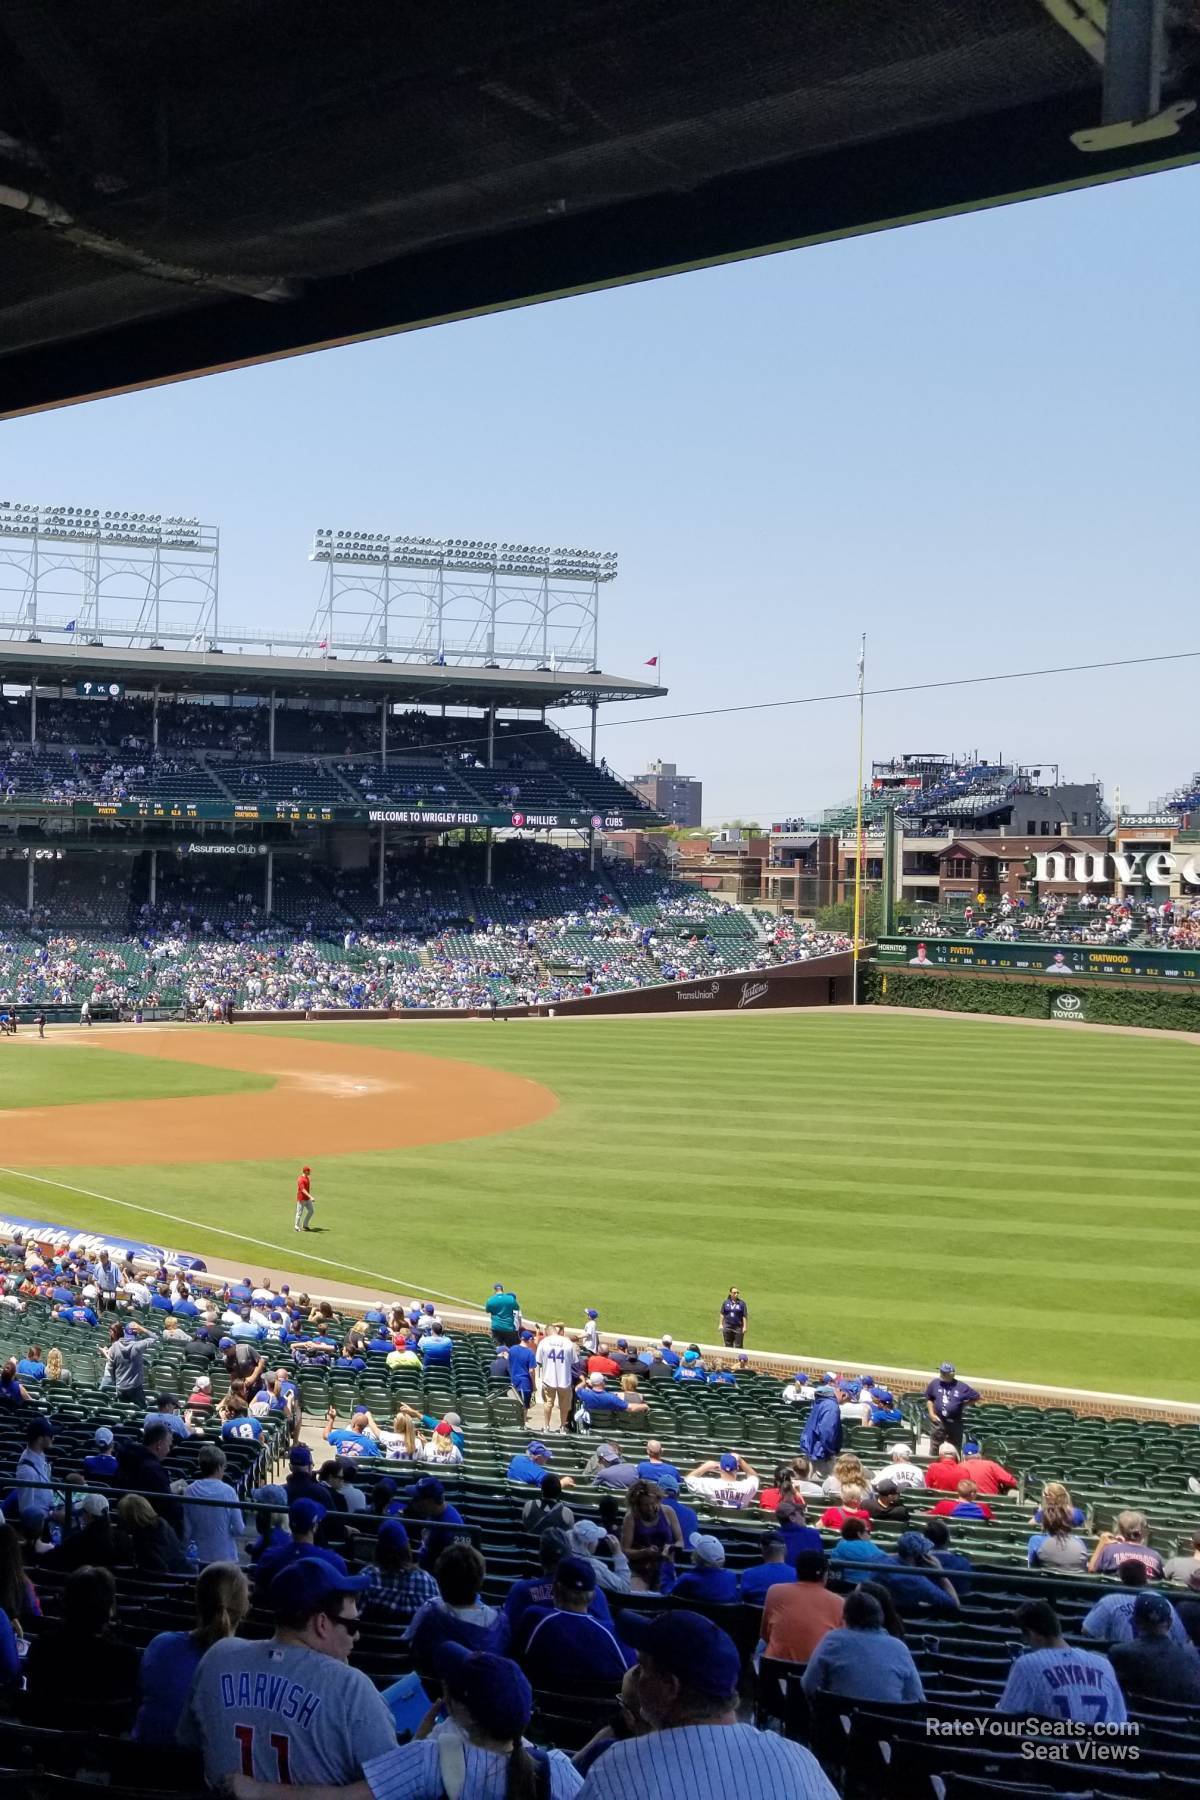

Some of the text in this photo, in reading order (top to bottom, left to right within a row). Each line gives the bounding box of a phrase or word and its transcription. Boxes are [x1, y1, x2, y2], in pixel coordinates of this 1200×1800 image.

[369, 811, 478, 823] WELCOME TO WRIGLEY FIELD
[526, 815, 558, 826] PHILLIES
[605, 817, 623, 827] CUBS
[188, 843, 256, 854] Assurance Club
[950, 946, 974, 955] PIVETTA
[1089, 953, 1128, 964] CHATWOOD
[676, 991, 714, 1000] TransUnion
[738, 981, 768, 1008] Jostens
[1053, 1010, 1084, 1019] TOYOTA
[548, 1349, 565, 1363] 44
[896, 1472, 915, 1481] BAEZ
[1042, 1665, 1104, 1688] BRYANT
[220, 1671, 321, 1728] DARVISH
[1053, 1695, 1108, 1723] 17
[234, 1723, 293, 1785] 11
